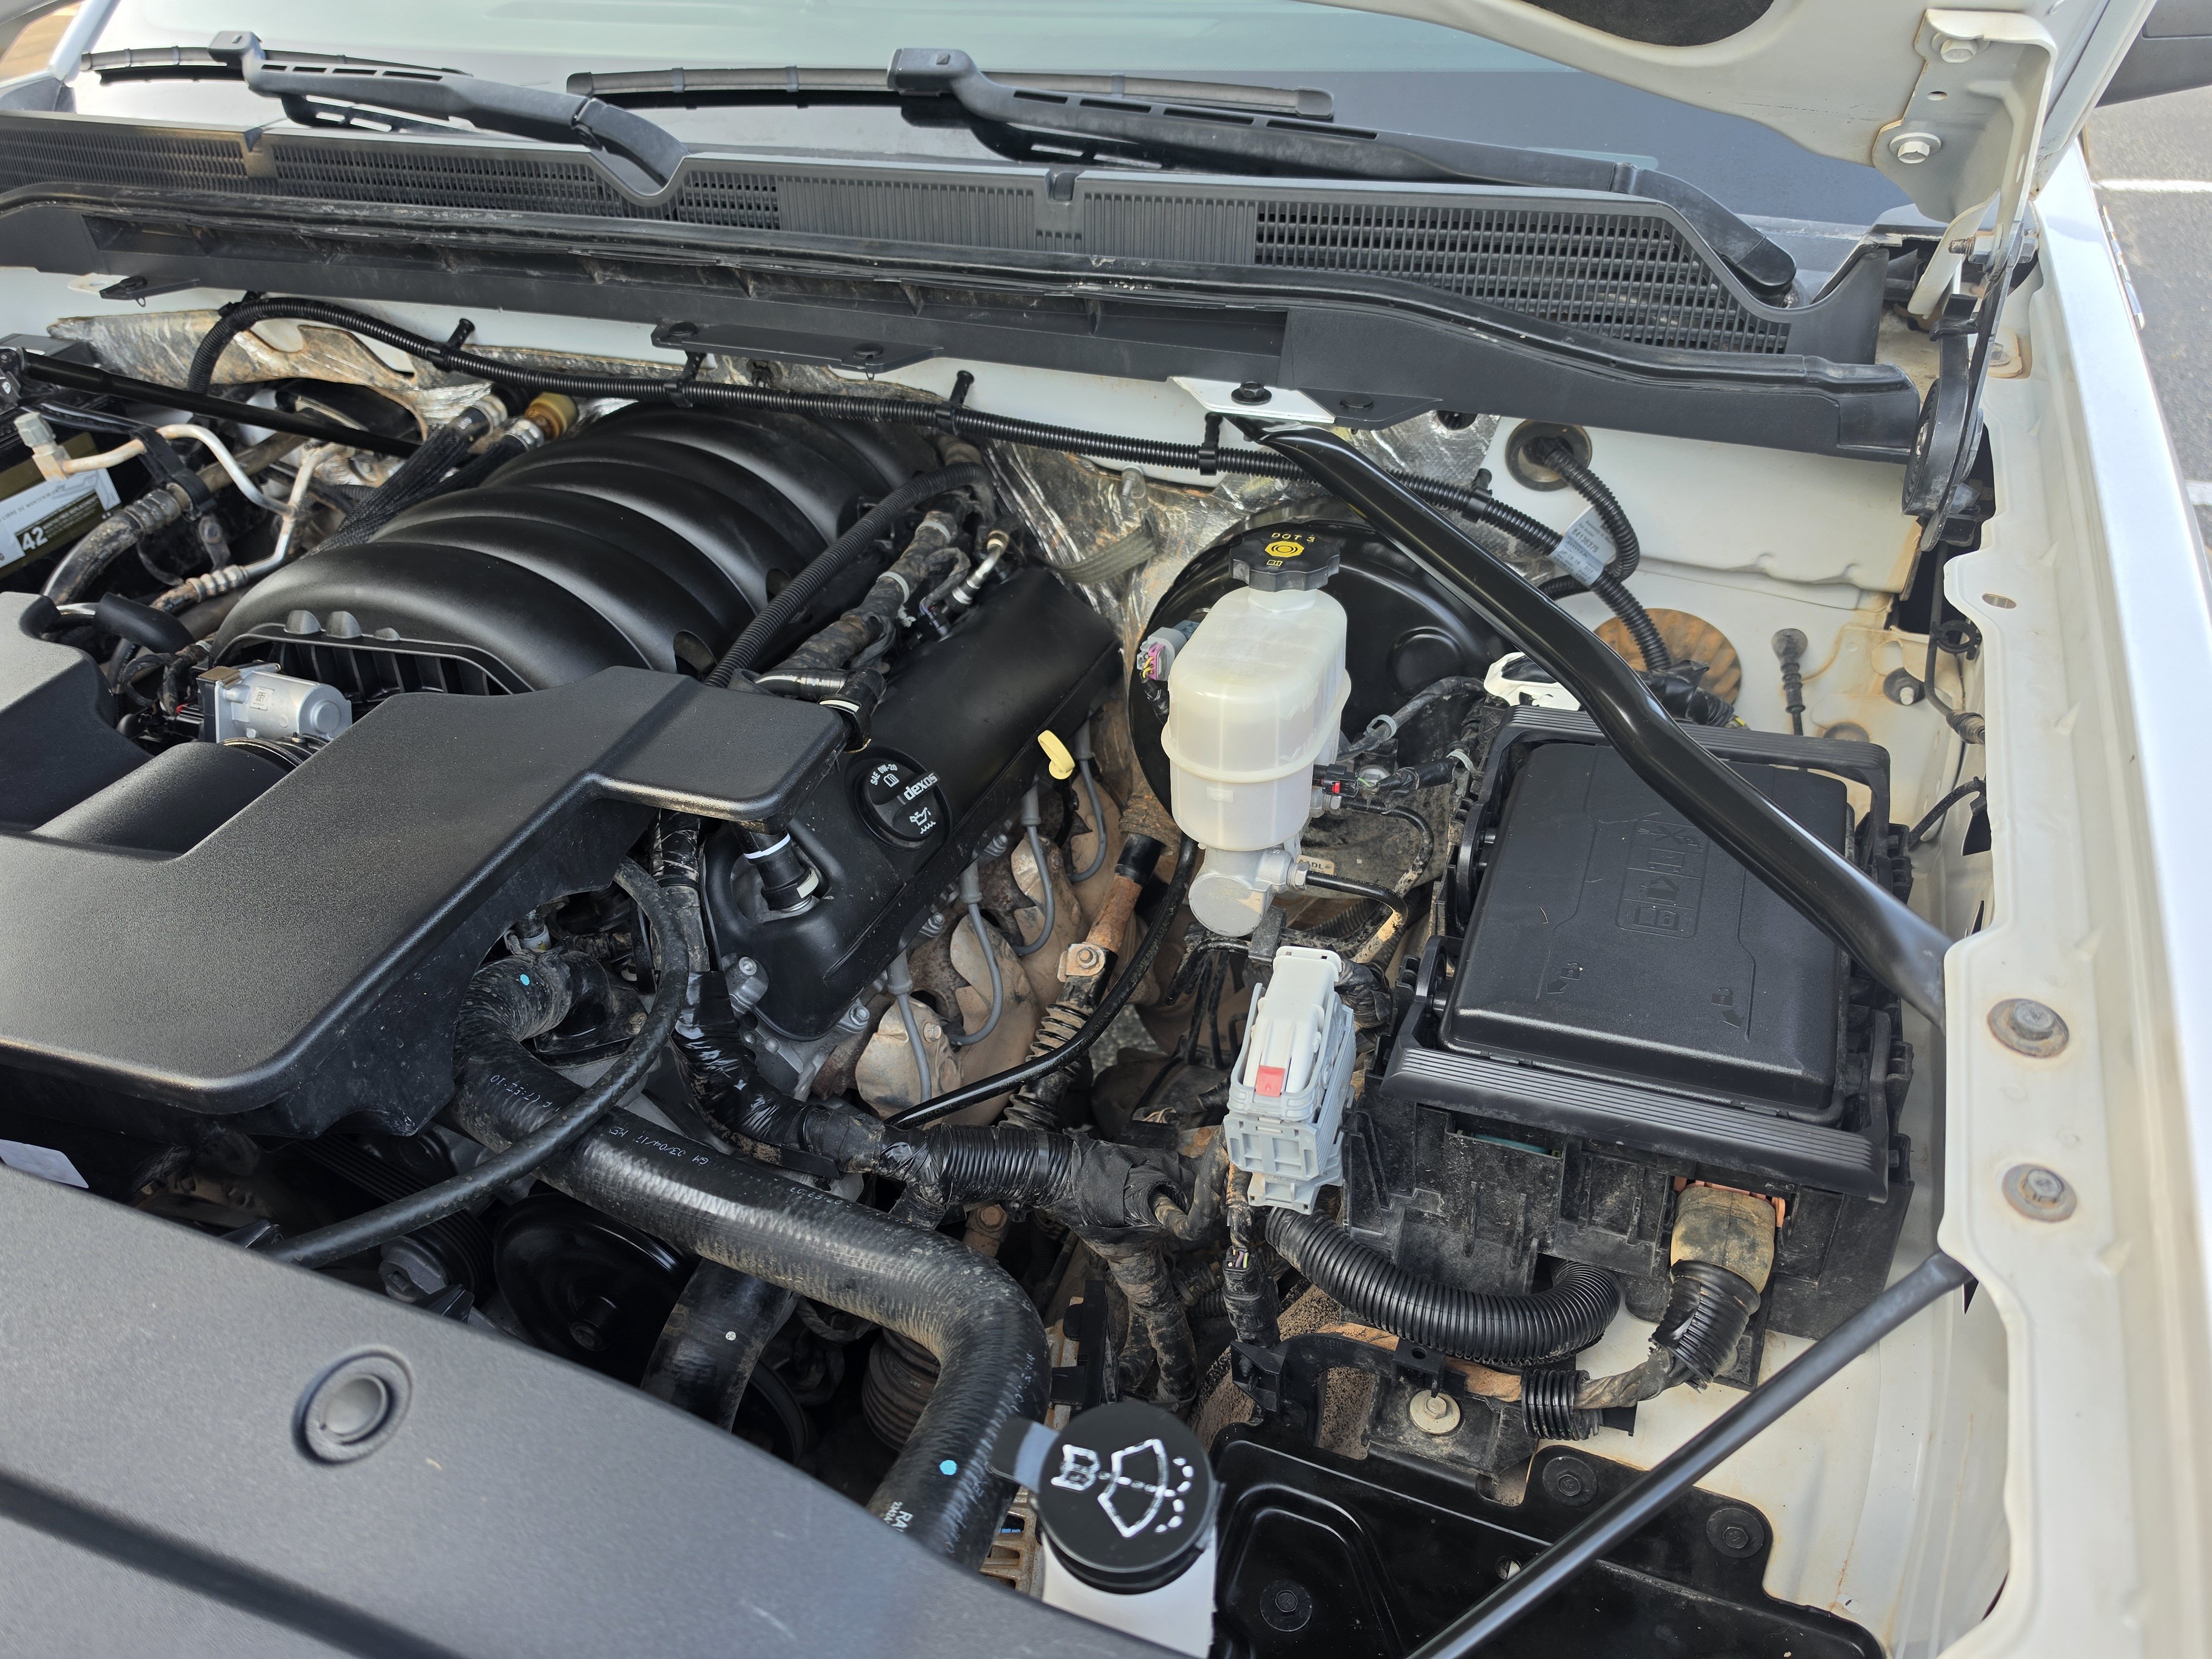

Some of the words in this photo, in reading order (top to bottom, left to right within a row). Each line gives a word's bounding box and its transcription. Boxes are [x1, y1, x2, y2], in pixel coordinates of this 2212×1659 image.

[22, 526, 49, 551] 42
[1271, 532, 1302, 541] DOT
[1306, 534, 1316, 543] 3
[870, 771, 880, 785] SAE
[877, 764, 898, 774] 0W-20
[903, 773, 938, 801] dexos
[1298, 859, 1324, 870] DL
[692, 1155, 708, 1165] GM
